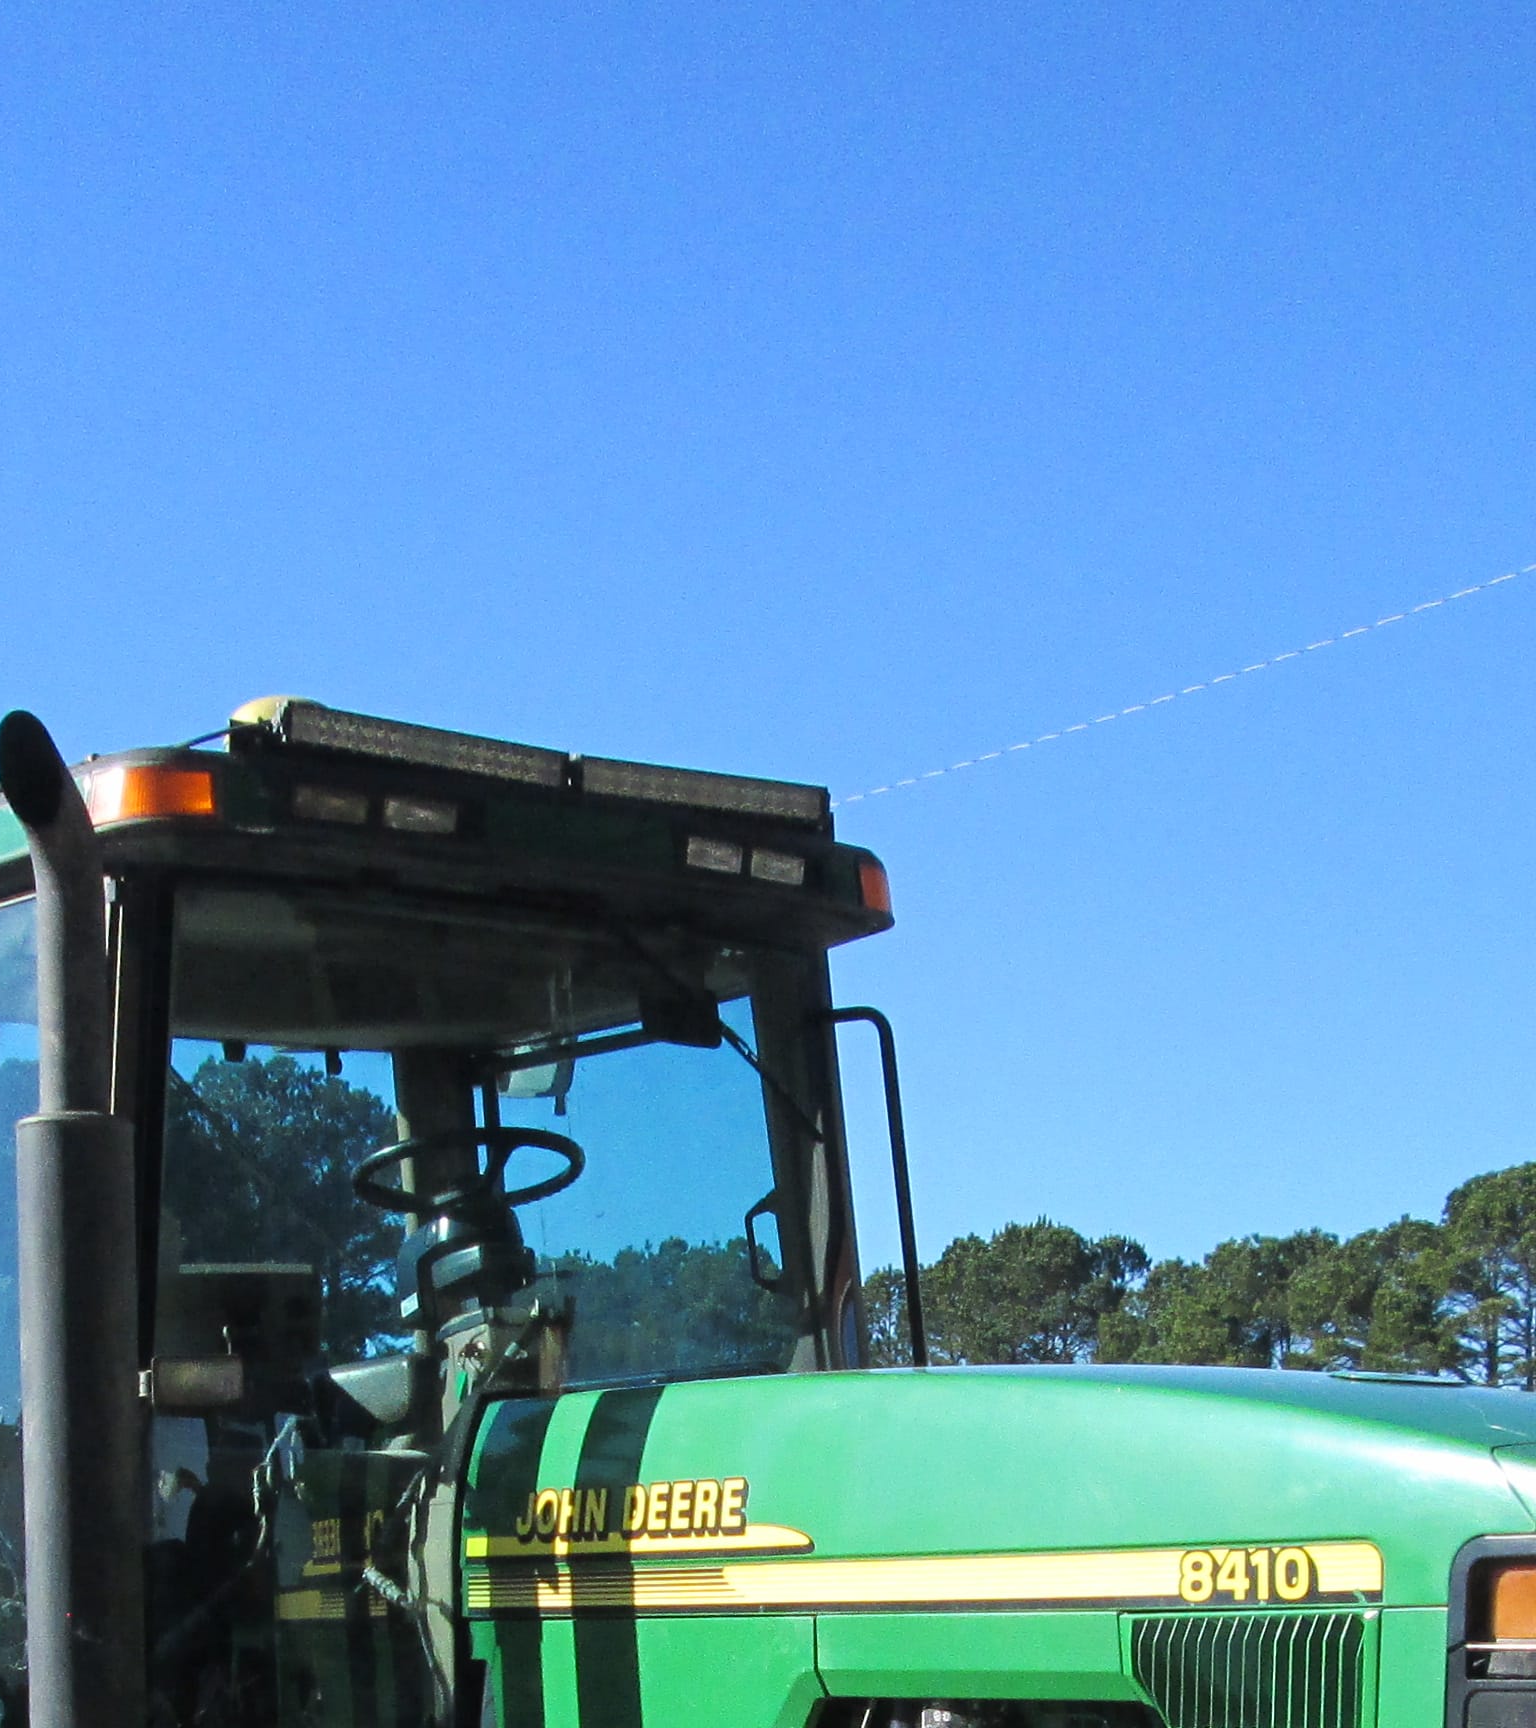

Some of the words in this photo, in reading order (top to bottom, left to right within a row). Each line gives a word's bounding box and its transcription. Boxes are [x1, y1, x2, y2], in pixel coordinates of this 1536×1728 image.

[516, 1486, 609, 1542] JOHN
[621, 1476, 750, 1539] DEERE
[1178, 1546, 1314, 1603] 8410
